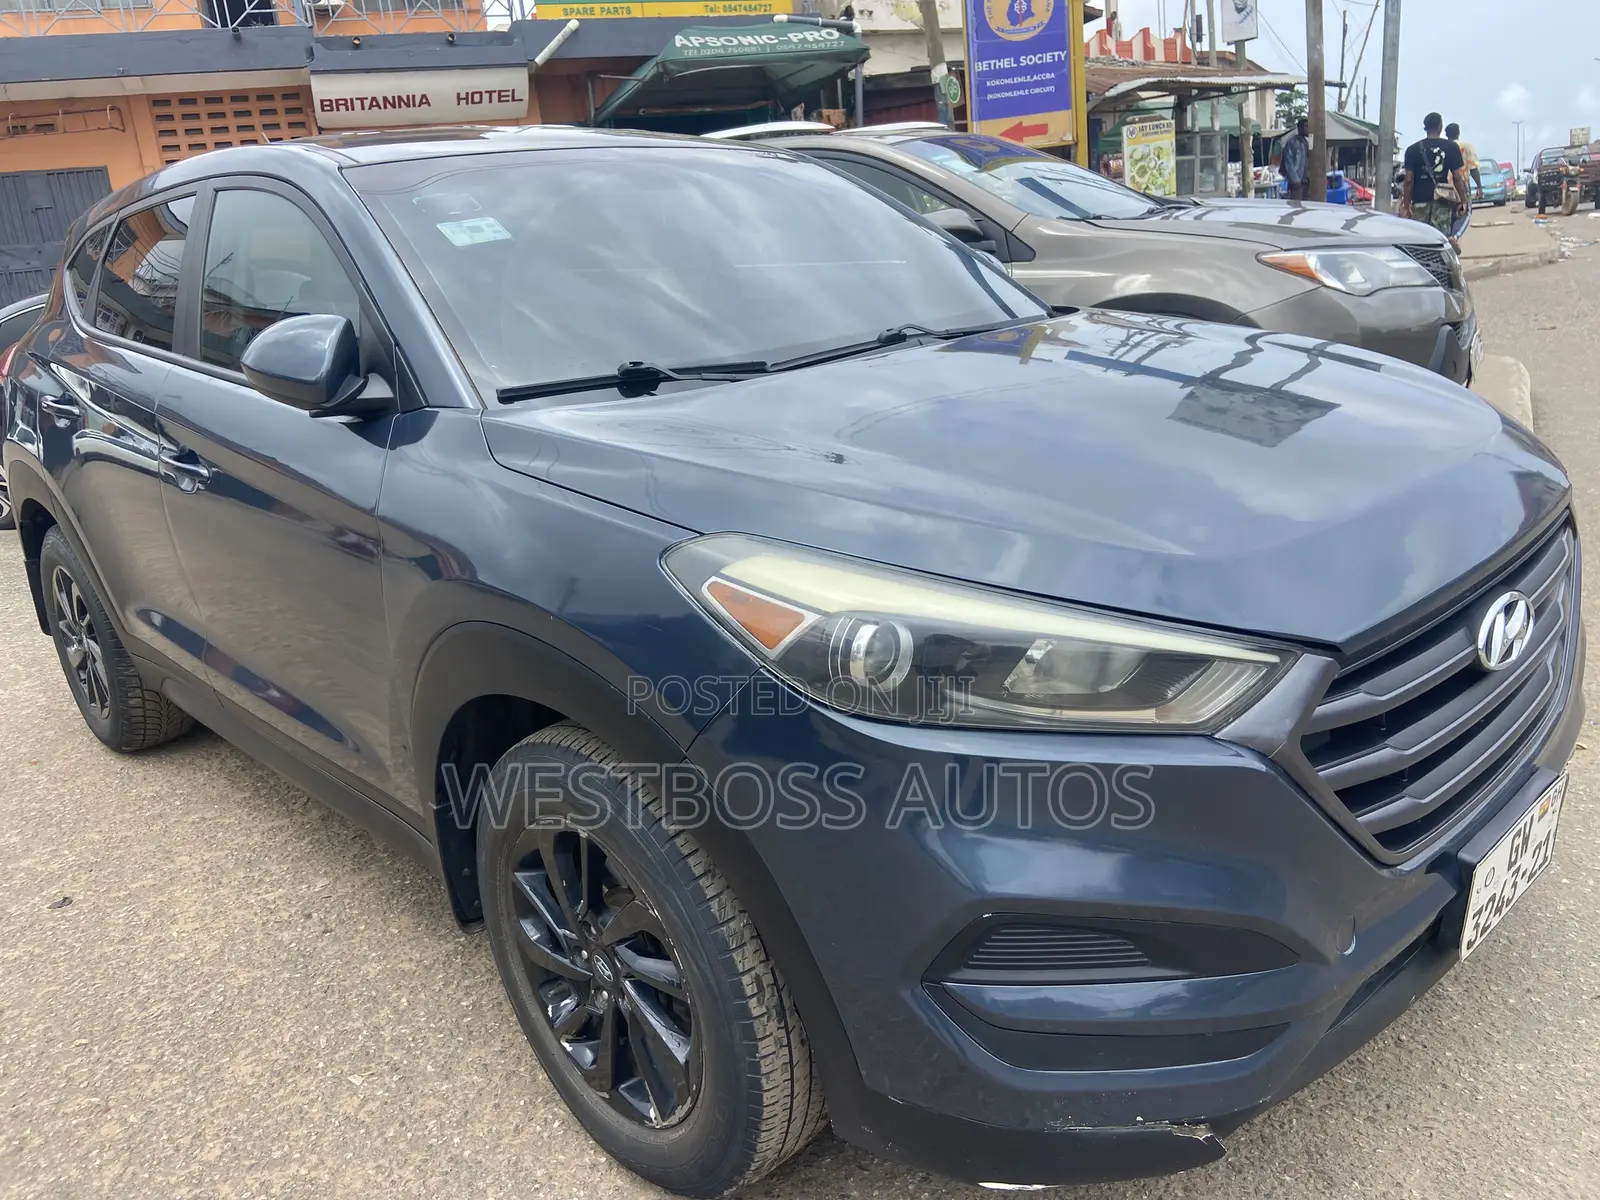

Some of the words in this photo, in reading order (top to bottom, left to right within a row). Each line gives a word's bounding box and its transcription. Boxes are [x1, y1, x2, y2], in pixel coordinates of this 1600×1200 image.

[562, 7, 595, 16] SPARE
[600, 6, 632, 16] PARTS
[674, 28, 840, 48] APSONIC-PRO
[974, 57, 1018, 72] BETHEL
[1019, 50, 1067, 66] SOCIETY
[319, 93, 432, 113] BRITANNIA
[456, 88, 524, 106] HOTEL
[1507, 814, 1534, 872] GW
[1466, 829, 1552, 951] 3243-21
